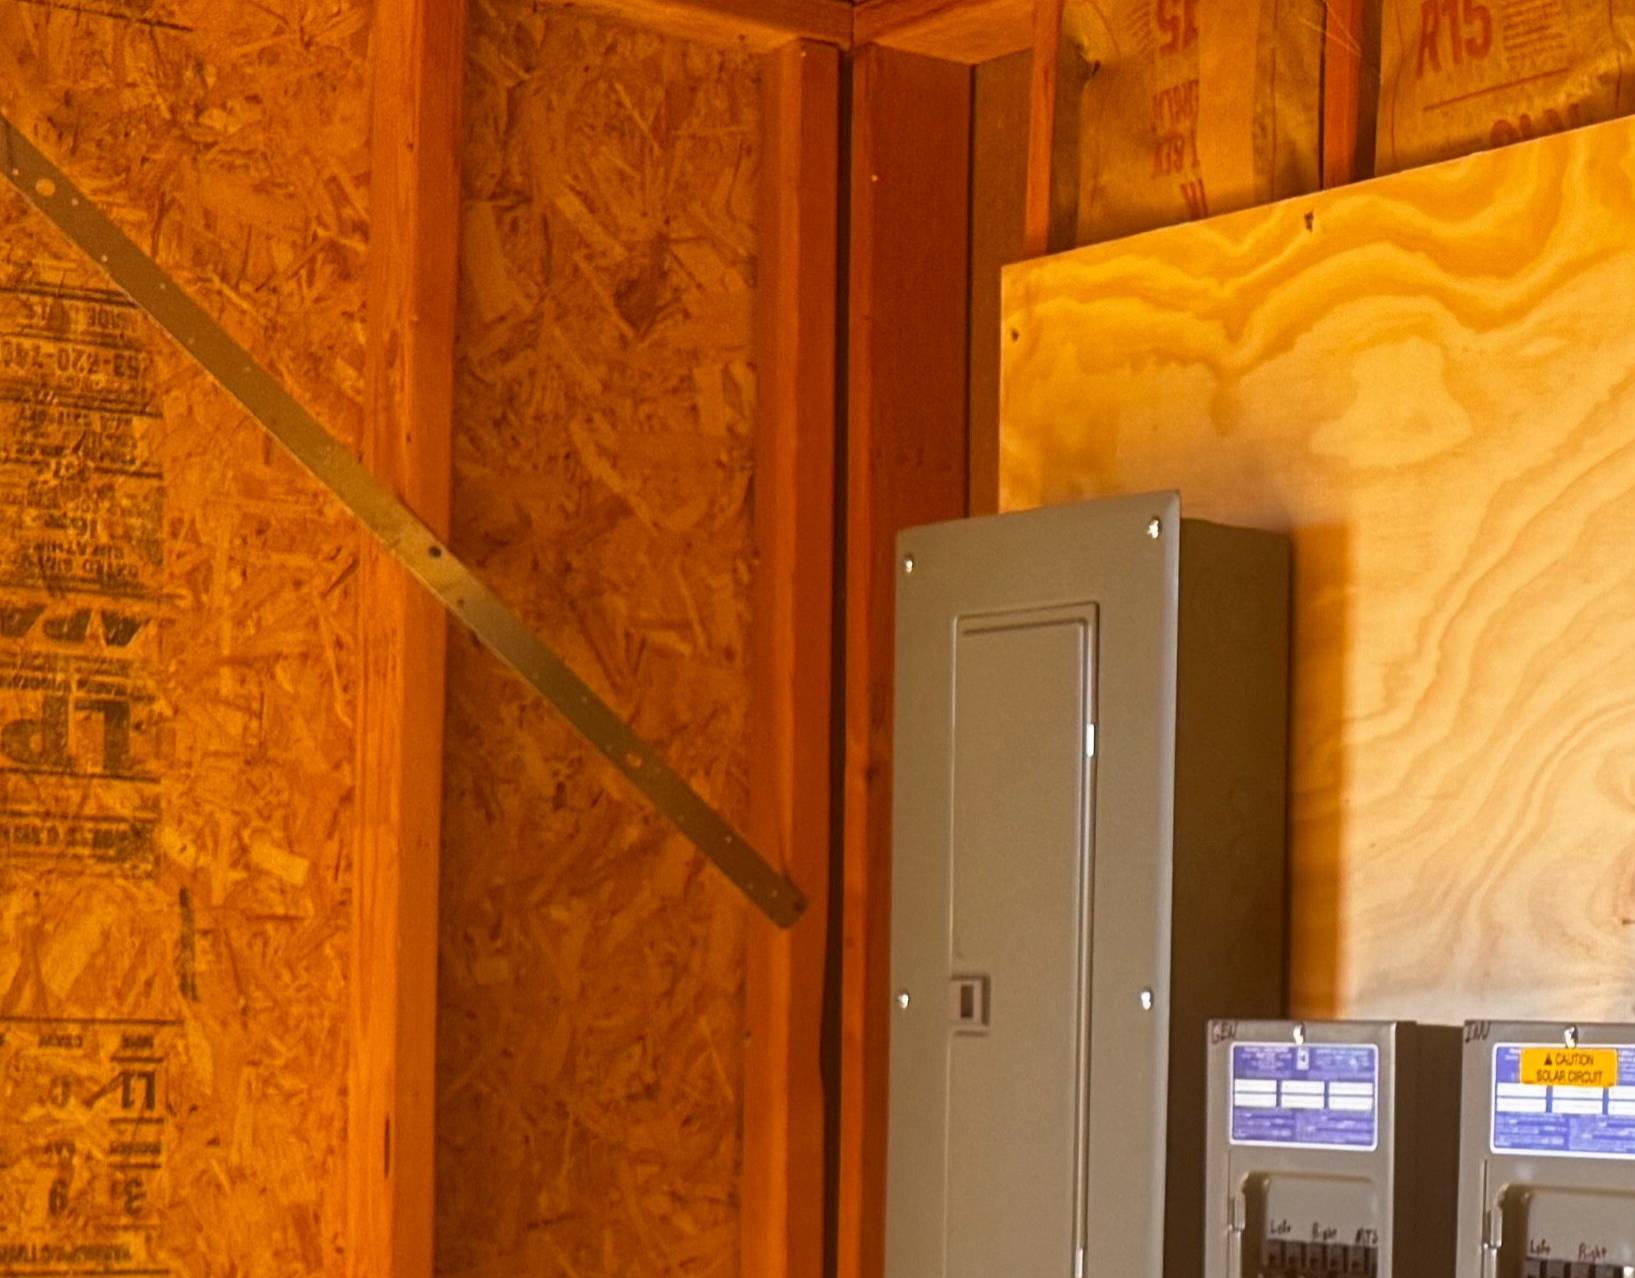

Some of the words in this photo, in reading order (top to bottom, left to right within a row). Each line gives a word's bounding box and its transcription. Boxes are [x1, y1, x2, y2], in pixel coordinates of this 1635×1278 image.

[0, 694, 132, 772] LP
[1555, 1052, 1595, 1067] CAUTION
[1536, 1069, 1565, 1083] SOLAR
[1567, 1070, 1604, 1084] CIRCUIT
